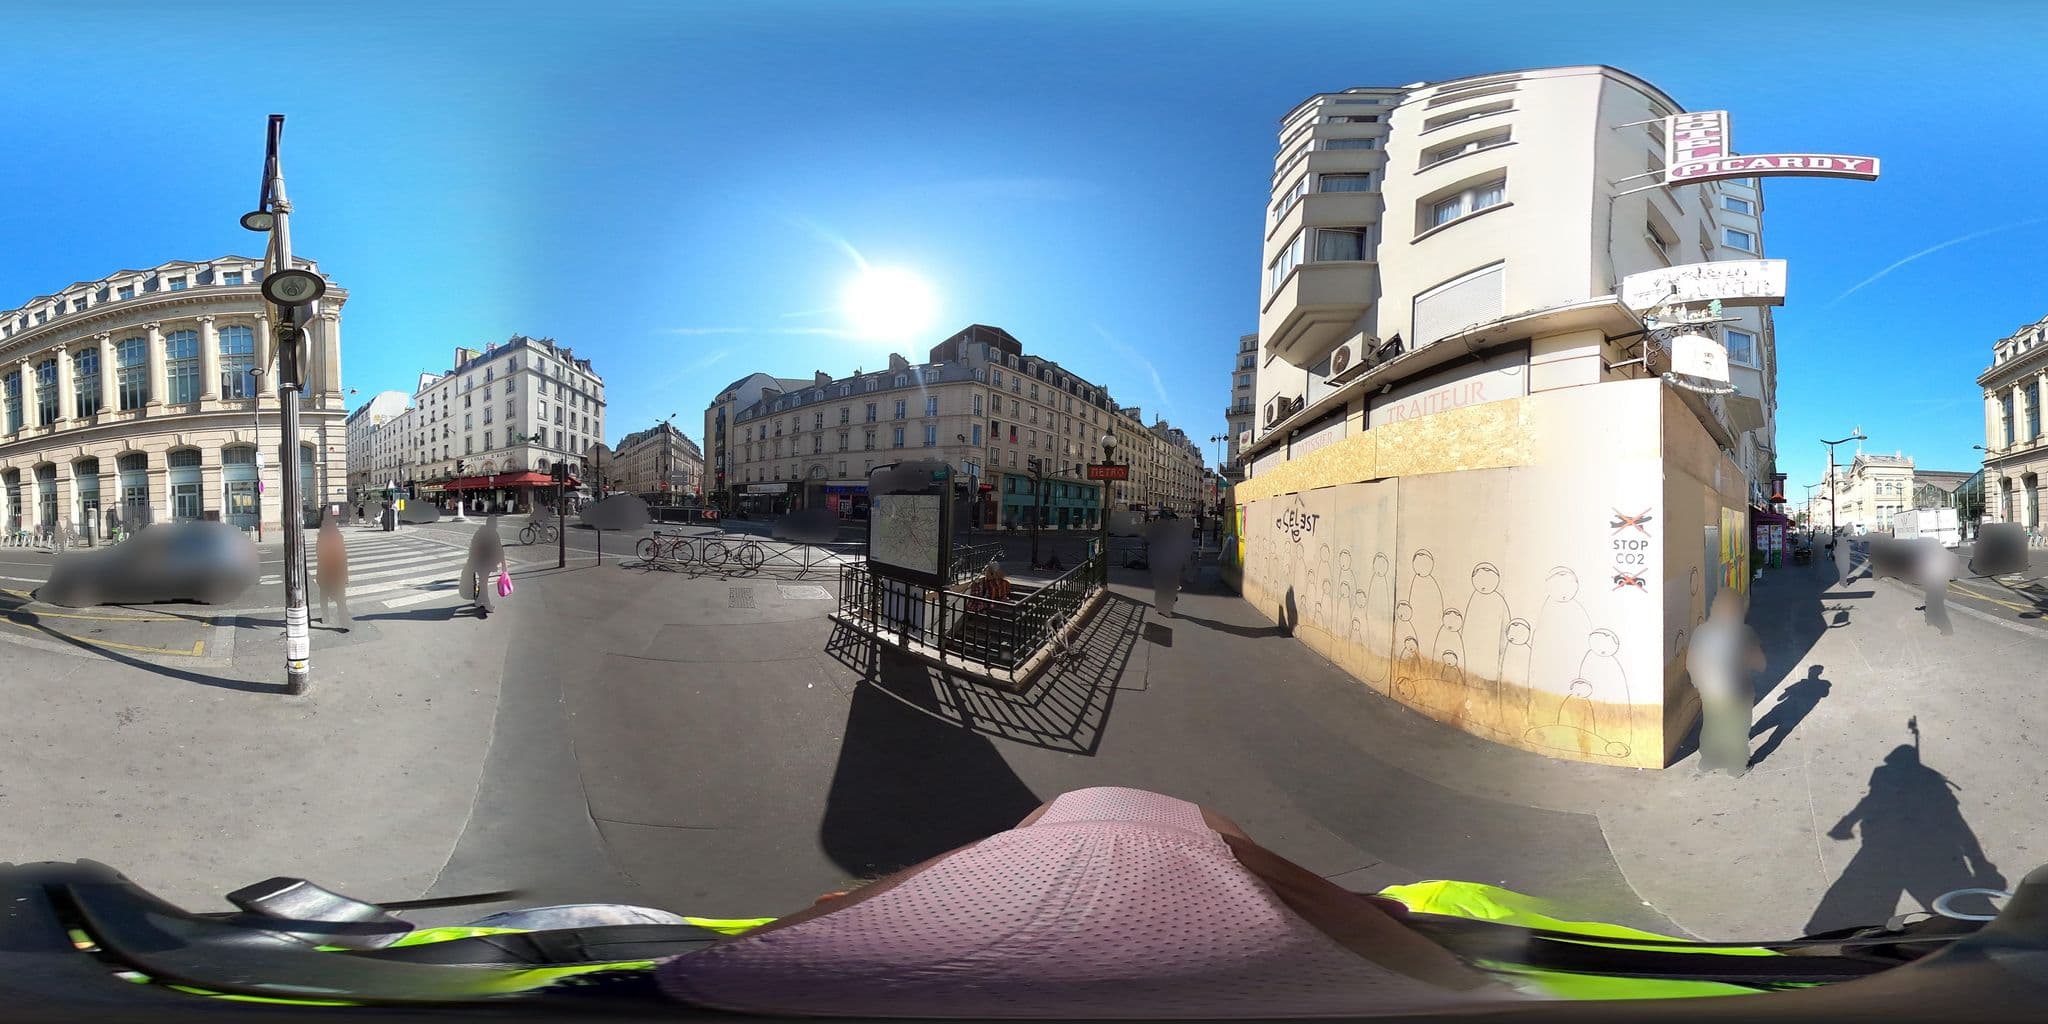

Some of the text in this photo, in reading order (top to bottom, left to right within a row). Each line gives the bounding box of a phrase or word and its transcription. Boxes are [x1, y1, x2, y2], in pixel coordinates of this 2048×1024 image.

[1675, 113, 1721, 163] HOTEL
[1680, 157, 1867, 177] PICARDY
[1386, 381, 1488, 424] TRAITEUR
[1613, 539, 1649, 551] STOP
[1615, 553, 1645, 565] CO2
